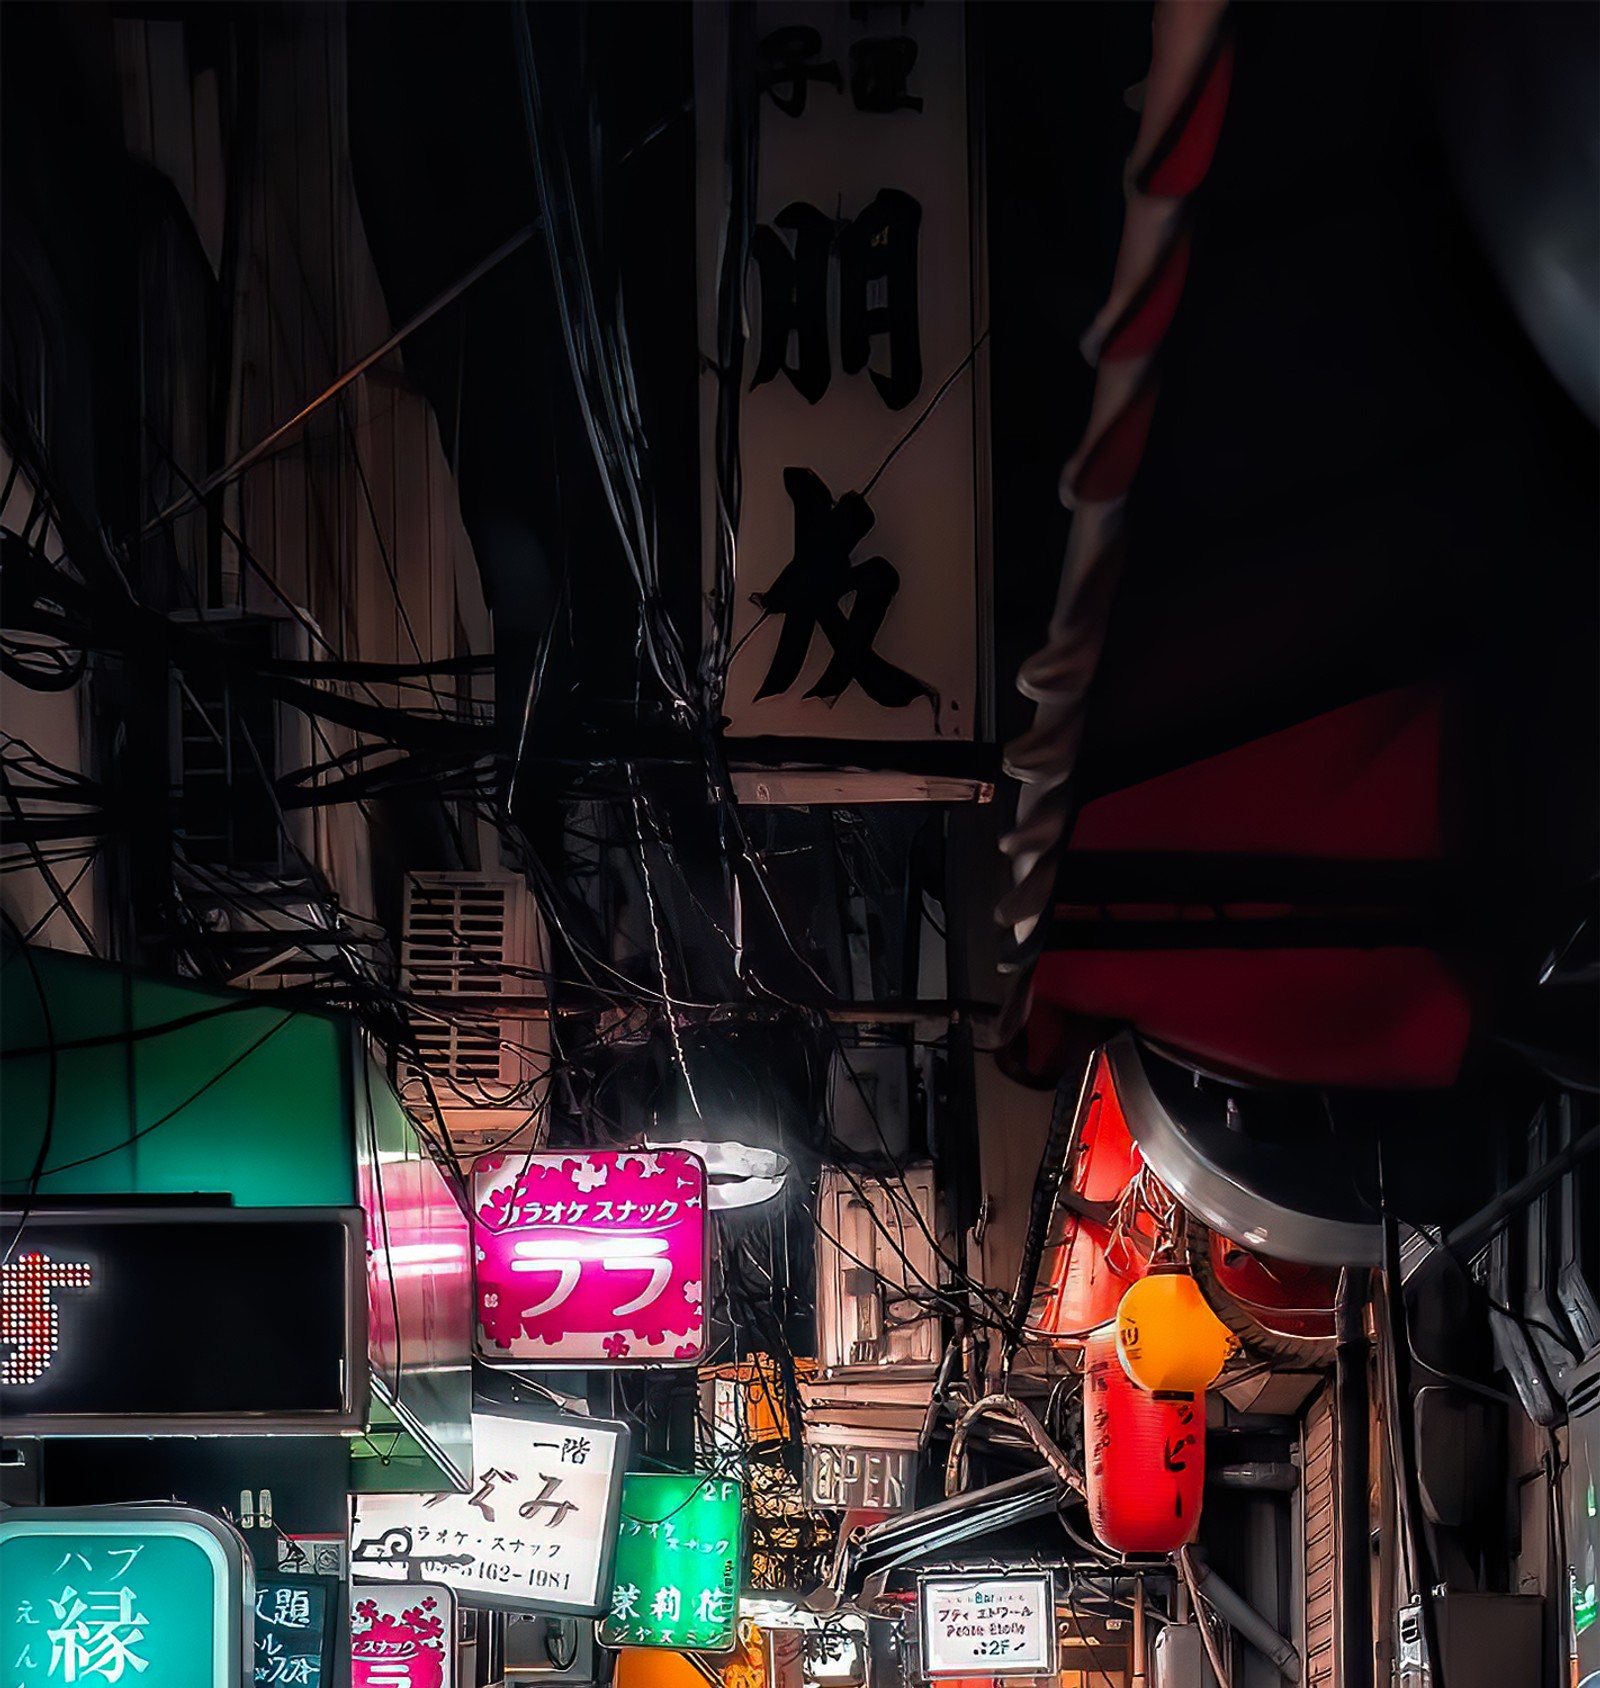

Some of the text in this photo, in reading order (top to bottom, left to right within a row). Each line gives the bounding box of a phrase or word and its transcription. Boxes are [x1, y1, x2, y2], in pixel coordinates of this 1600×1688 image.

[498, 1200, 678, 1224] カラオケ スナック
[511, 1237, 673, 1318] ララ
[533, 1436, 591, 1465] 一階
[702, 1480, 733, 1501] 2F
[46, 1585, 150, 1684] 縁
